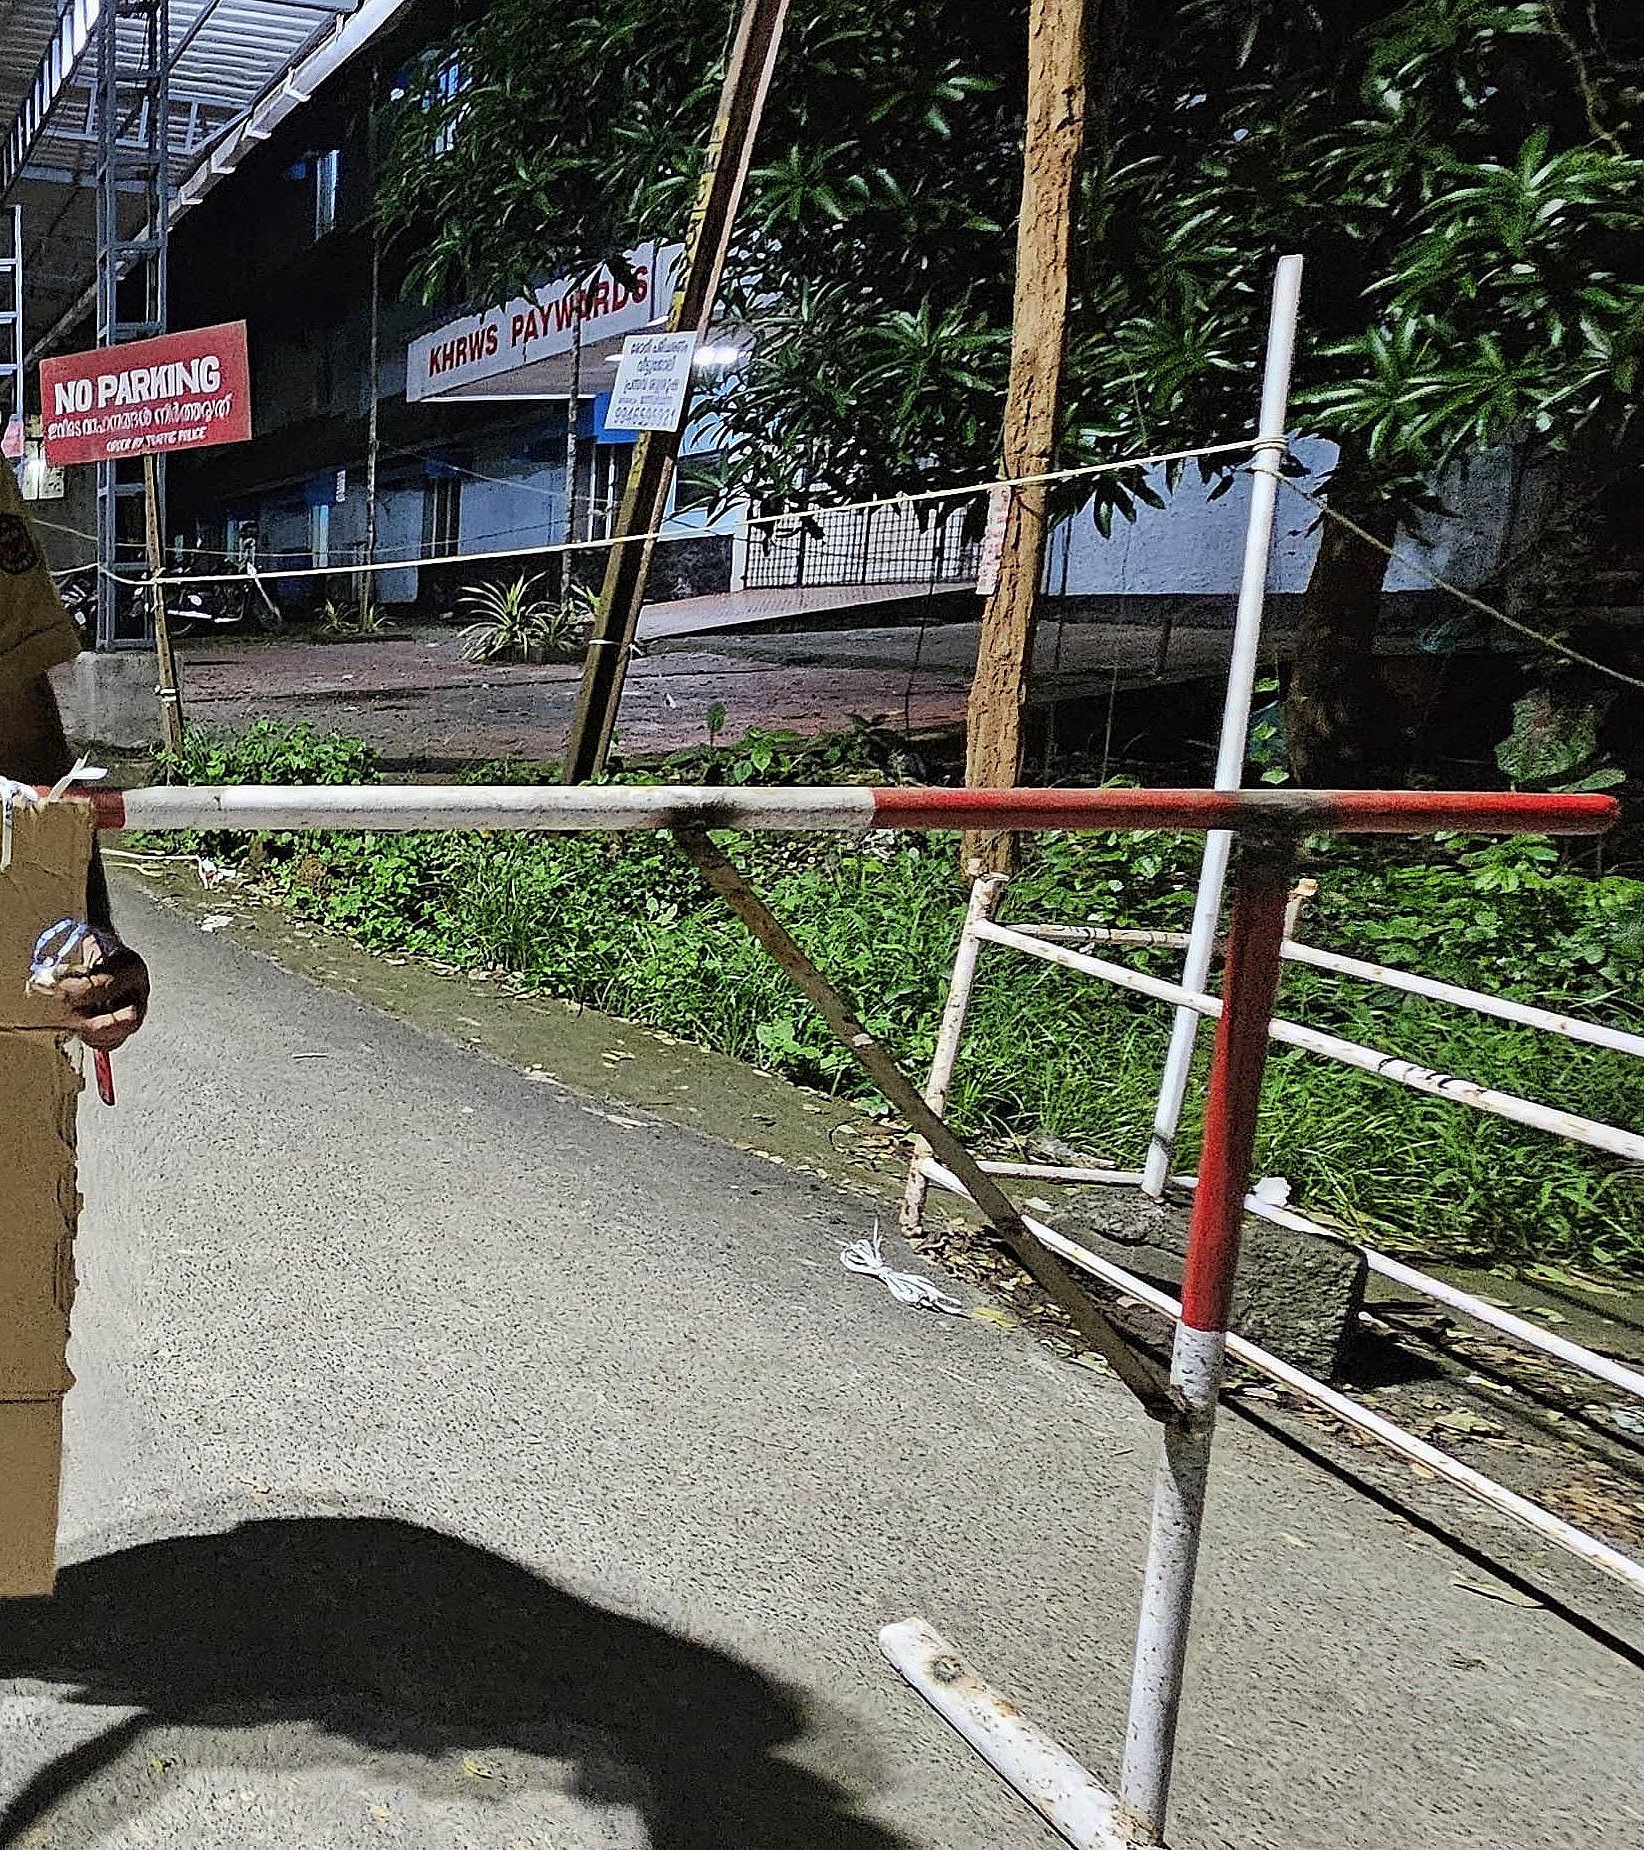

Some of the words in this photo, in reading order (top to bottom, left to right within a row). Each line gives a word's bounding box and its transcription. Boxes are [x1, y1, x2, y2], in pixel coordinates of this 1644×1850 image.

[429, 324, 499, 378] KHRWS
[54, 379, 93, 416] NO
[97, 355, 222, 409] PARKING
[178, 426, 208, 442] POLICE
